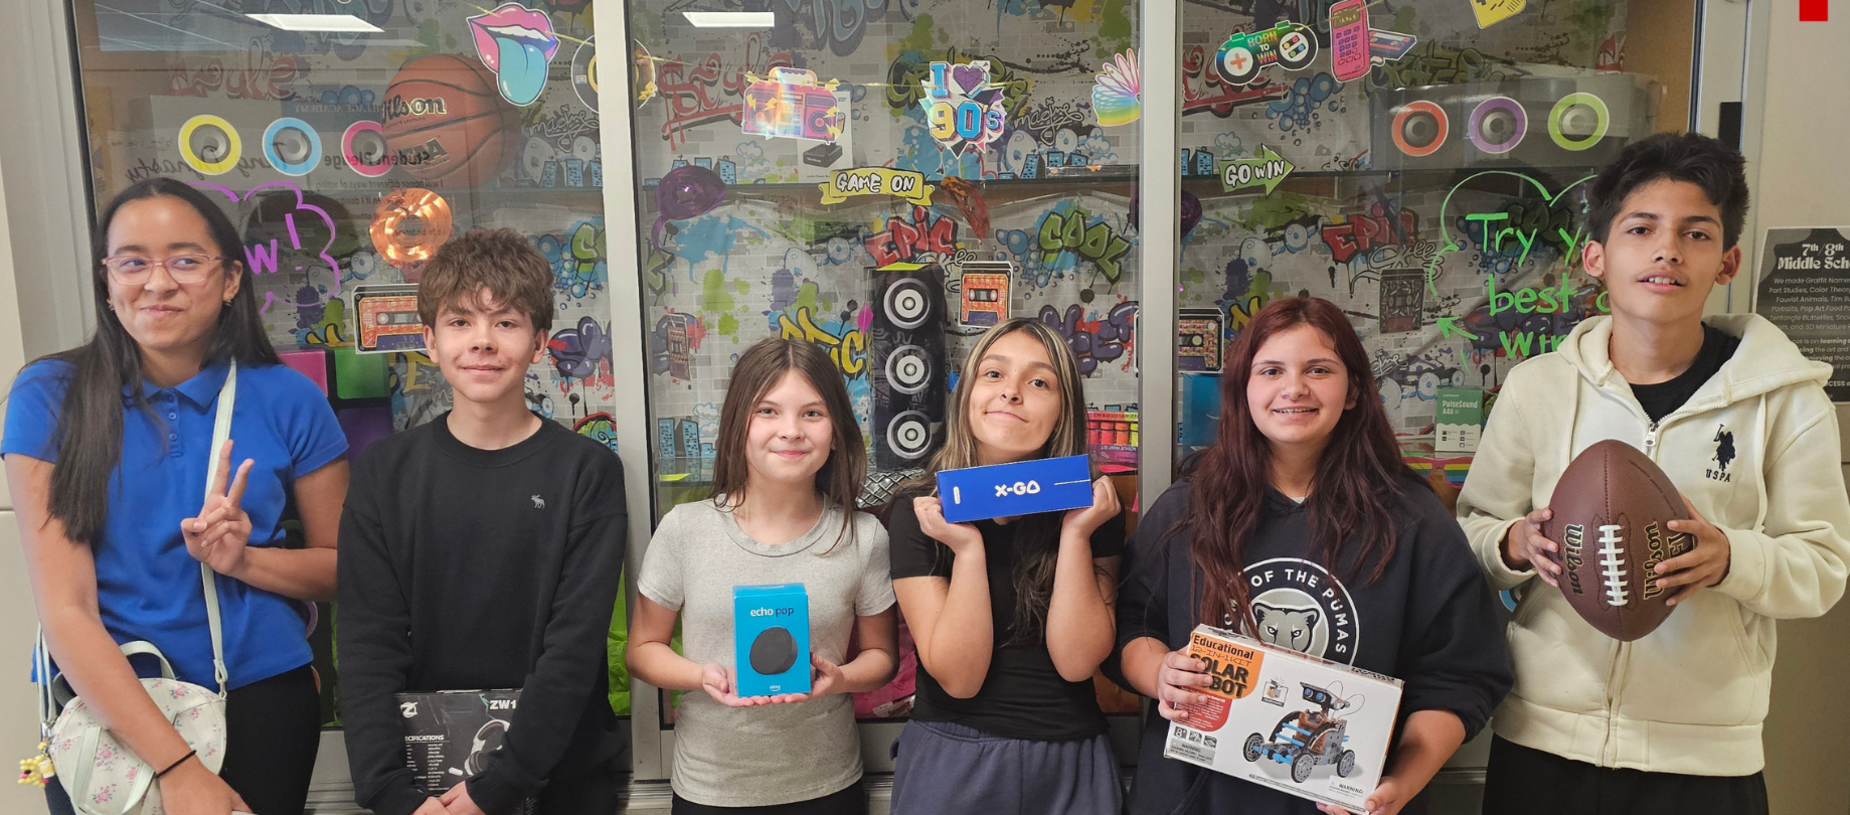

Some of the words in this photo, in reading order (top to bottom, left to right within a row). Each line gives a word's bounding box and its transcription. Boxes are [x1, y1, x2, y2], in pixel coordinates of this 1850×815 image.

[1247, 31, 1278, 47] BORN
[1259, 44, 1270, 52] TO
[1256, 51, 1278, 65] WIN
[930, 101, 1002, 142] 90's
[836, 172, 882, 193] GAME
[890, 174, 916, 192] ON
[1224, 164, 1252, 187] GO
[1254, 160, 1286, 180] WIN
[1038, 210, 1132, 285] COOL
[1465, 212, 1537, 267] Try
[1777, 256, 1821, 270] Middle
[1824, 256, 1850, 270] Sch
[1488, 272, 1578, 316] best
[1800, 306, 1813, 314] Pop
[1442, 400, 1478, 409] PulseSound
[1705, 468, 1731, 483] USPA
[994, 480, 1041, 498] X-GO
[1563, 523, 1585, 596] Wilson
[750, 606, 774, 617] echo
[775, 607, 794, 617] pop
[1250, 570, 1274, 587] OF
[1284, 568, 1320, 589] THE
[1322, 587, 1350, 654] PUMAS
[1193, 634, 1254, 660] Educational
[1207, 675, 1248, 699] BOT
